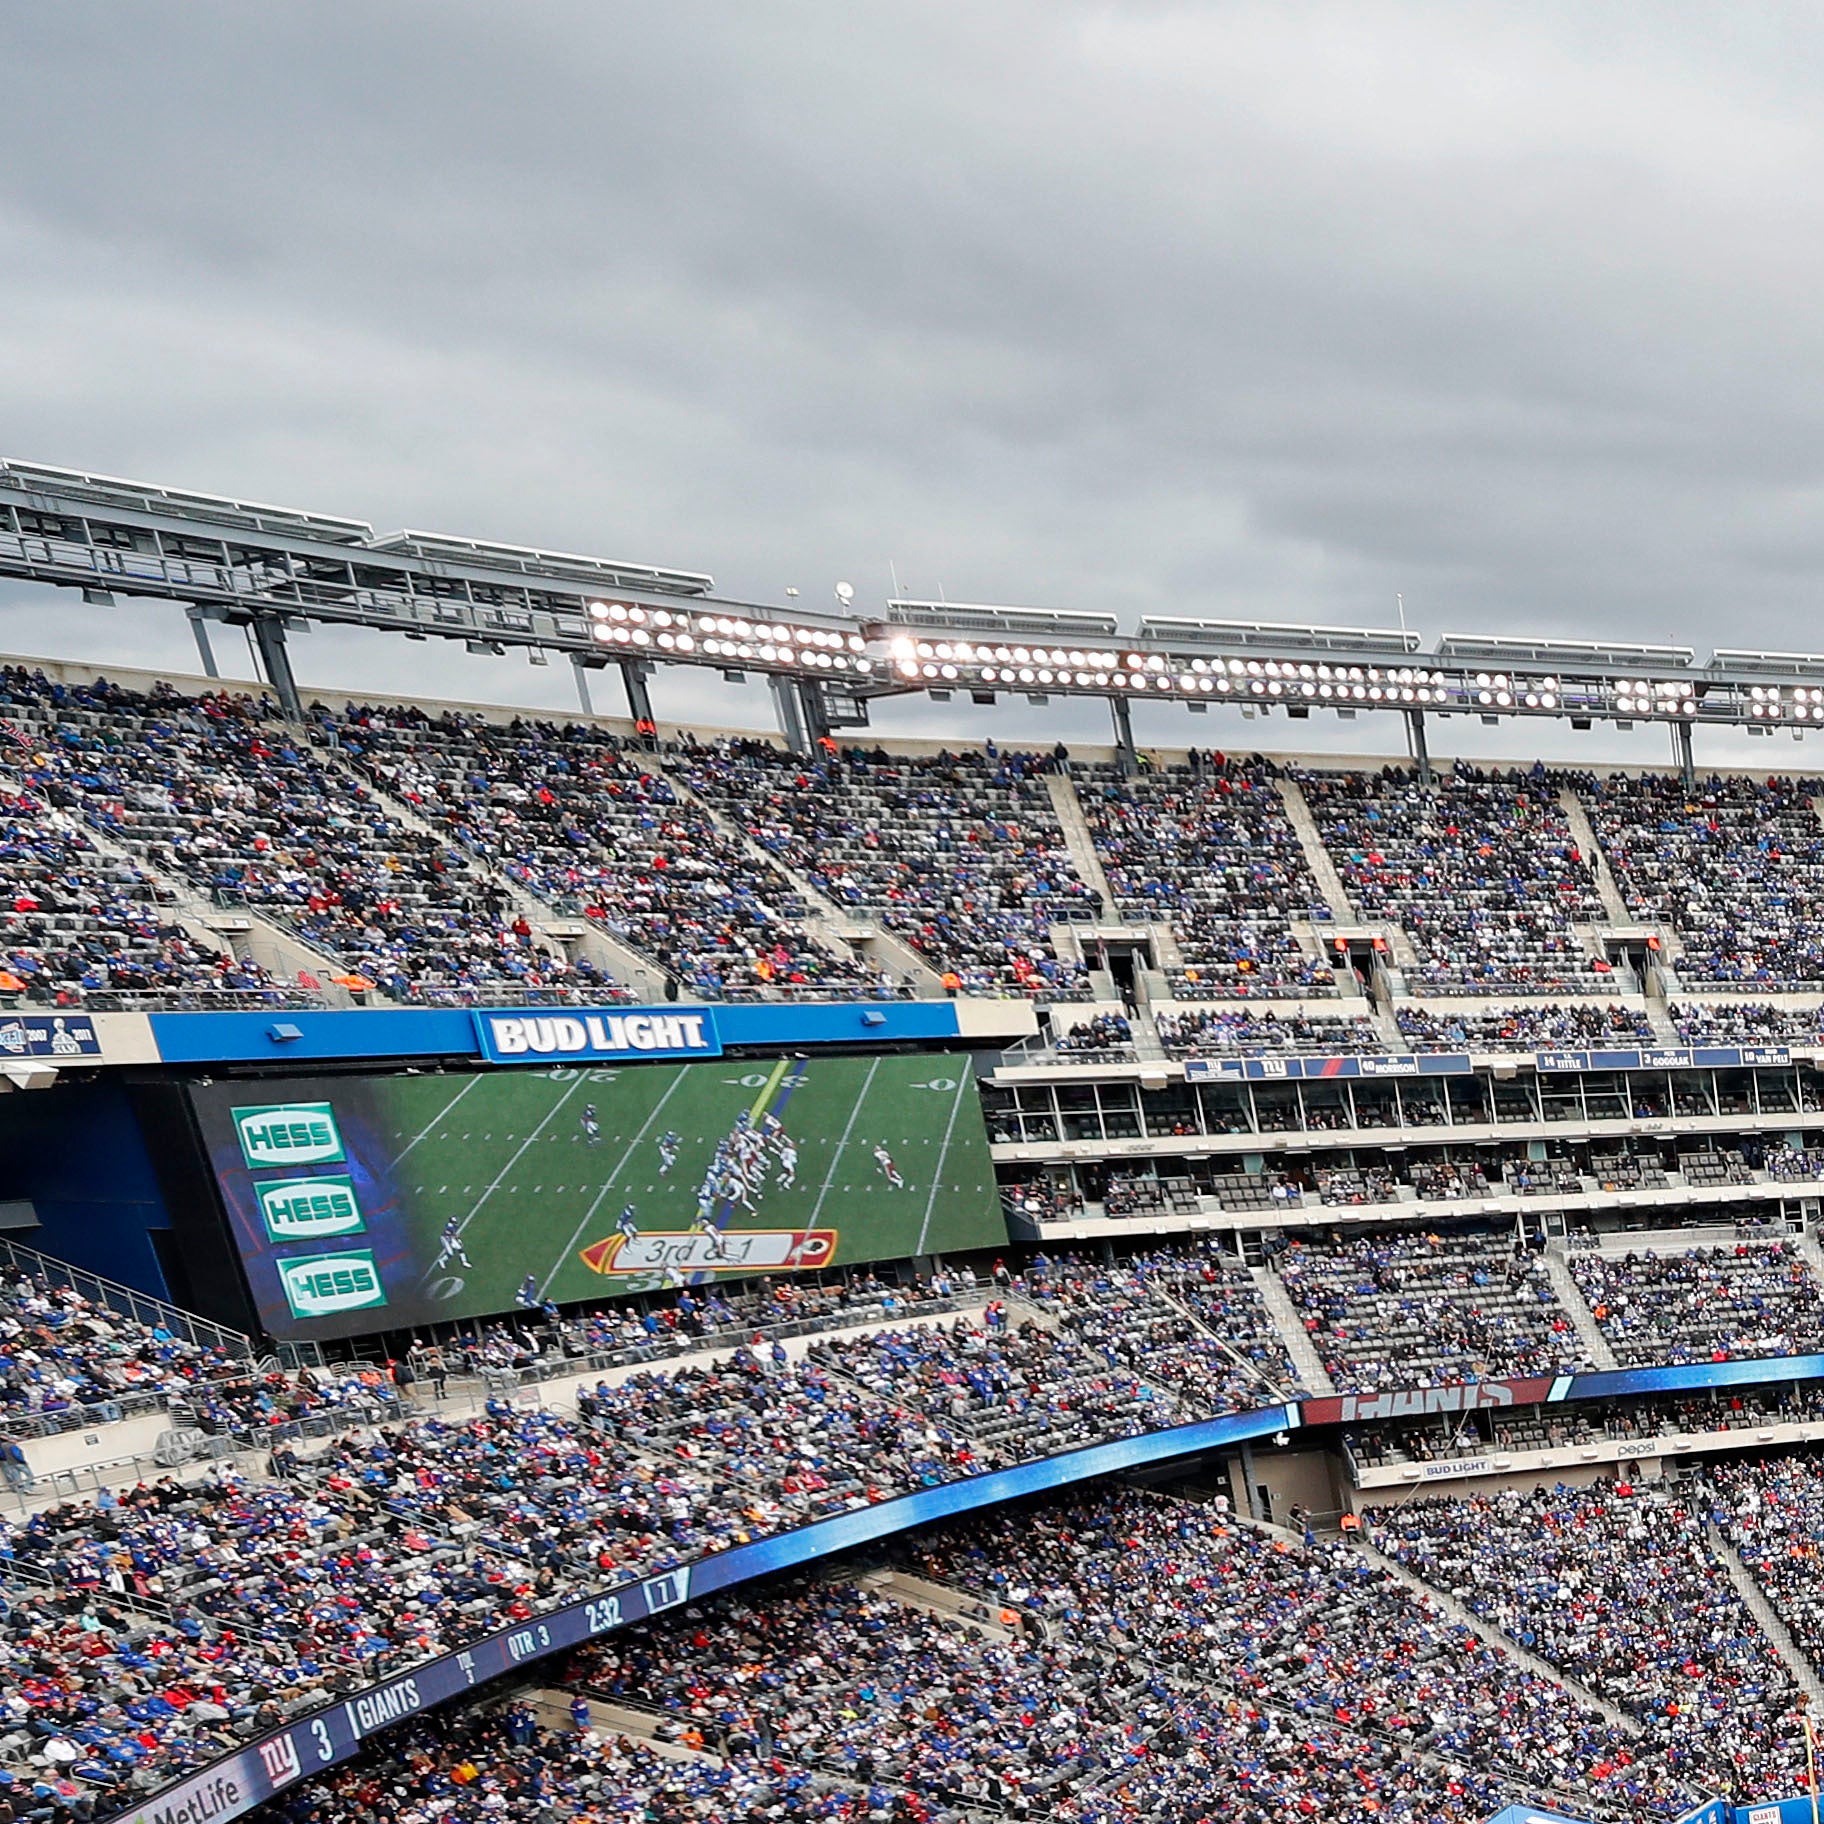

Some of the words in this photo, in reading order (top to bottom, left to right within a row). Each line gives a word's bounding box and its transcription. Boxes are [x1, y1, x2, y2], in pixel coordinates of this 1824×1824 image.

[490, 1018, 587, 1053] BUD
[585, 1015, 704, 1051] LIGHT
[247, 1122, 333, 1150] HESS
[270, 1194, 352, 1224] HESS
[645, 1239, 697, 1262] 3rd
[741, 1239, 754, 1259] 1
[292, 1268, 373, 1300] HESS
[1617, 1443, 1655, 1458] pepsi
[1427, 1465, 1451, 1476] BUD
[1453, 1461, 1487, 1474] LIGHT
[596, 1597, 637, 1634] 2:32
[512, 1632, 542, 1662] QTR
[542, 1625, 559, 1646] 3
[358, 1679, 421, 1730] GIANTS
[312, 1717, 334, 1762] 3
